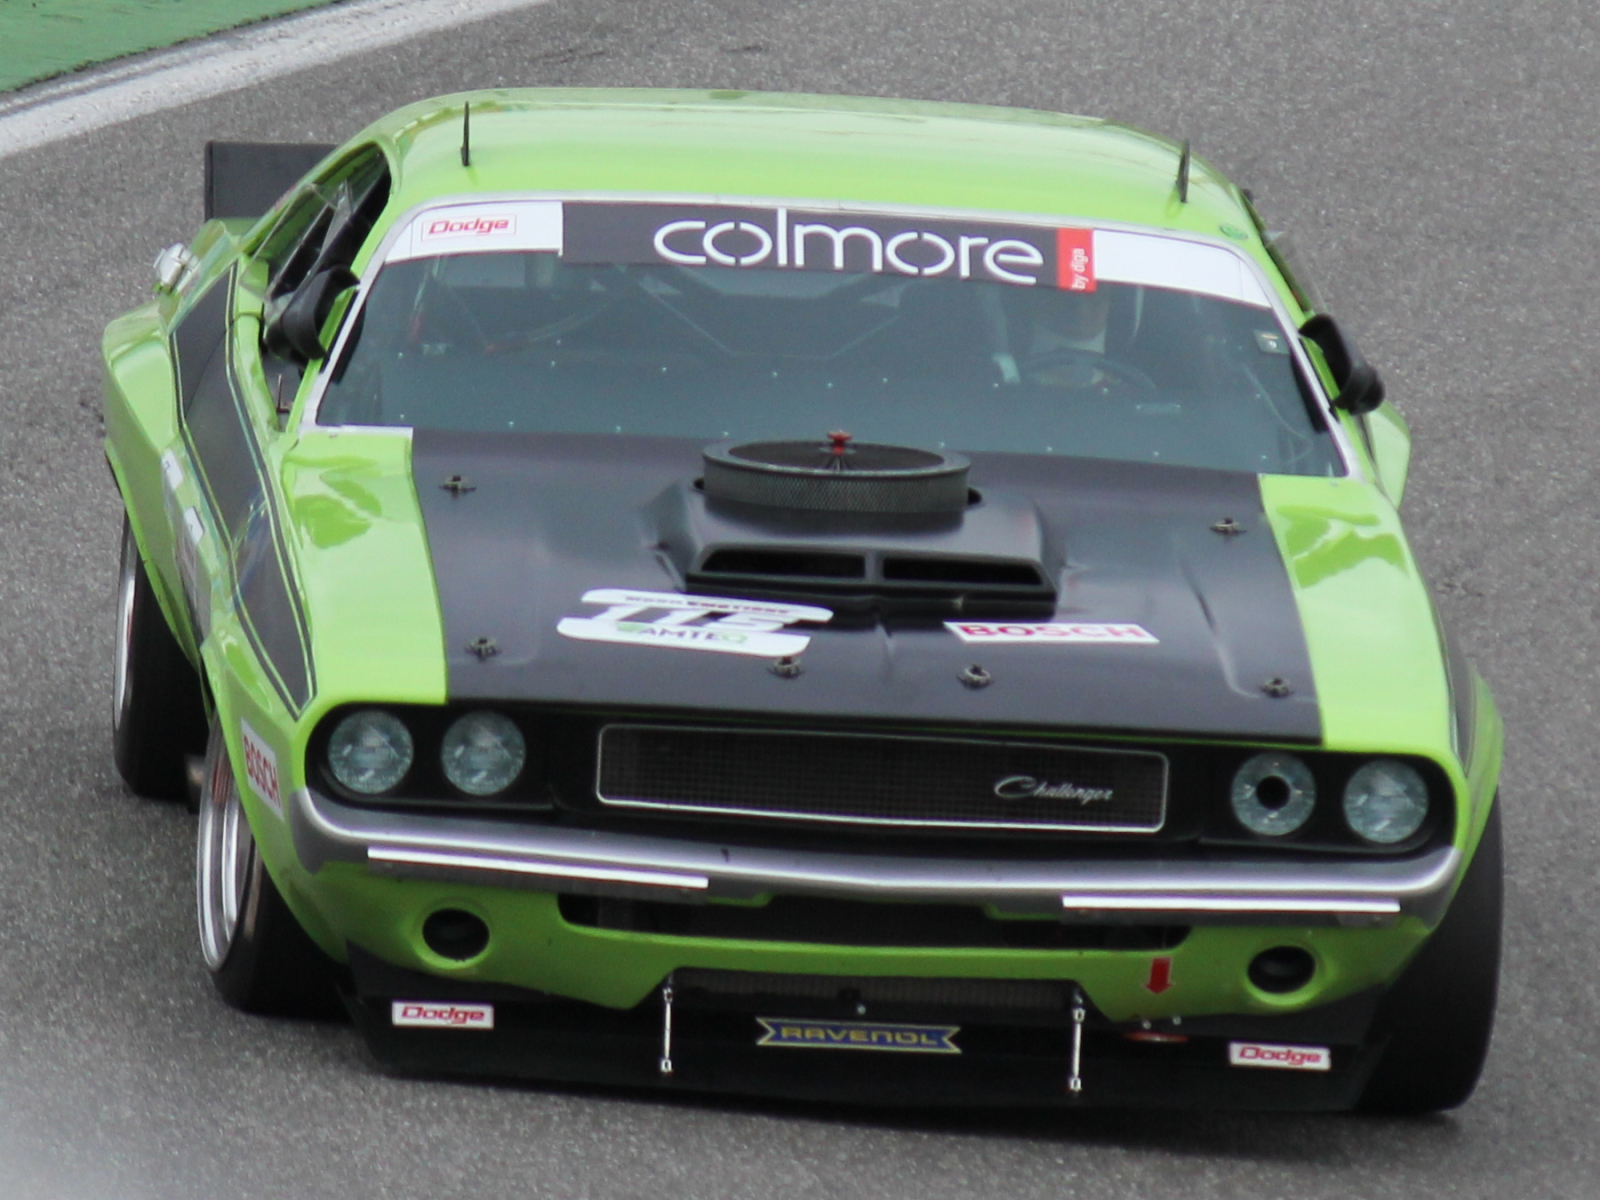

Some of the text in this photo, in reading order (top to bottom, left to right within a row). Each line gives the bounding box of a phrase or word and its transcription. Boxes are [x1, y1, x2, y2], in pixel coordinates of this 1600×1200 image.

[427, 217, 510, 236] Dodge
[653, 206, 1044, 285] colmore
[1071, 247, 1089, 290] by diga
[957, 624, 1148, 638] BOSCH
[242, 733, 282, 810] BOSCH
[993, 775, 1114, 805] Challenger
[401, 1005, 485, 1025] Dodge
[780, 1026, 938, 1045] RAVENOL
[1239, 1046, 1322, 1066] Dodge
